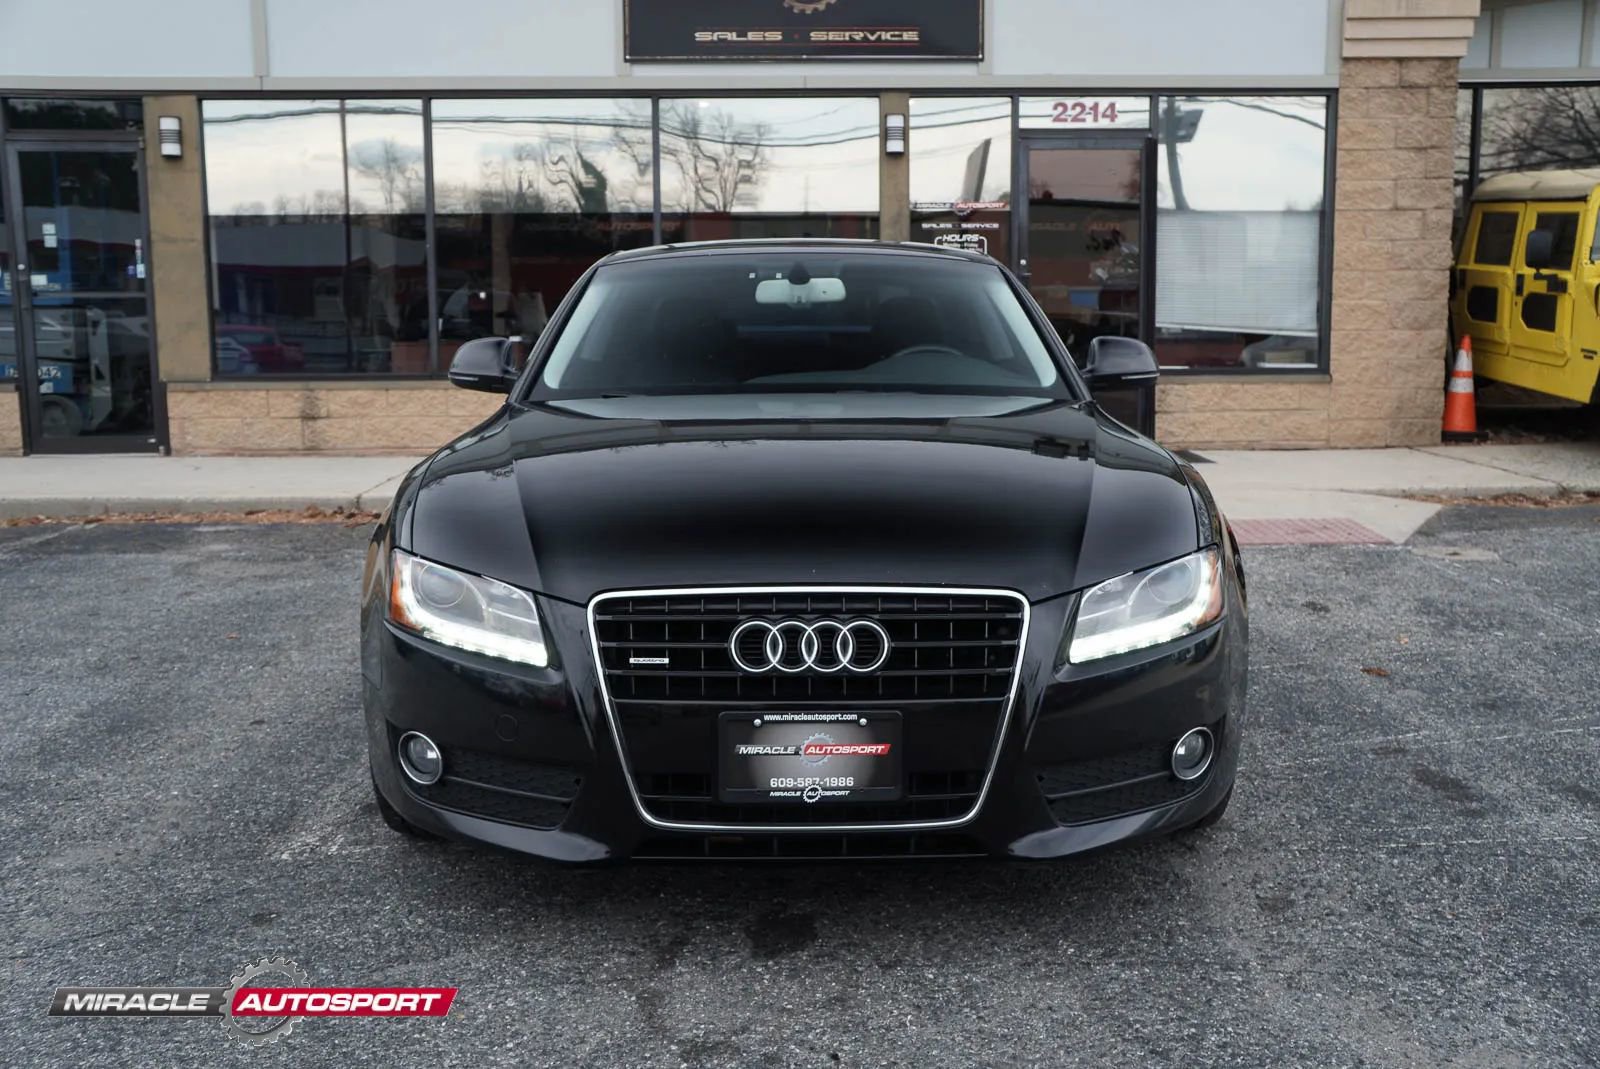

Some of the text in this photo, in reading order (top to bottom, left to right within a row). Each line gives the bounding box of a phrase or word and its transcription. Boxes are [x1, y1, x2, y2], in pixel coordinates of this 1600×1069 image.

[694, 31, 920, 42] SALES SERVICE
[1051, 102, 1119, 123] 2214
[942, 233, 980, 242] HOURS
[763, 713, 858, 721] www.miracleautosport.com
[738, 745, 885, 755] MIRACLE AUTOSPORT
[769, 776, 854, 788] 609-587-1986
